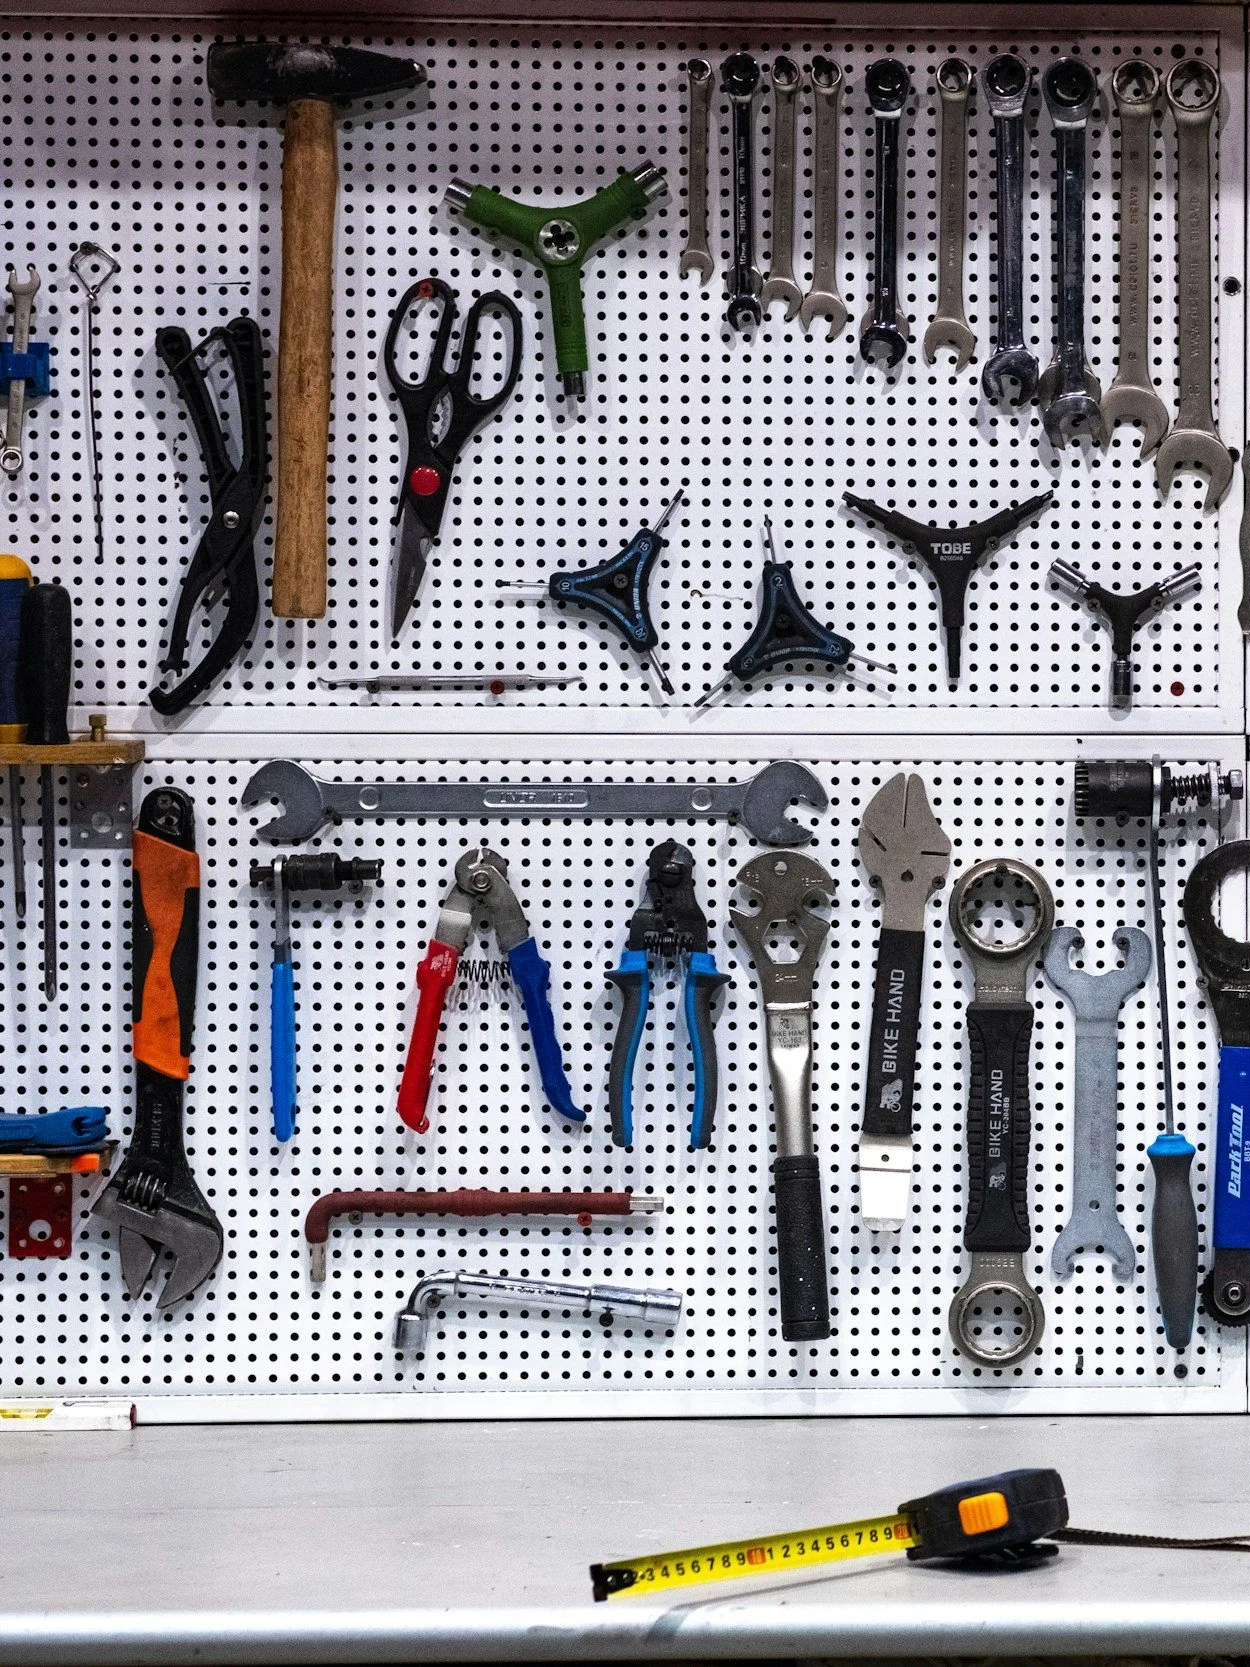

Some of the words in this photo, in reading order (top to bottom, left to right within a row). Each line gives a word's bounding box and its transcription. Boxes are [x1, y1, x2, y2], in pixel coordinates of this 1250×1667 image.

[639, 541, 650, 552] 15
[930, 542, 972, 555] TOBE
[561, 581, 570, 591] 10
[775, 576, 783, 587] 2
[886, 969, 905, 1023] HAND
[881, 1028, 900, 1073] BIKE
[990, 1069, 1003, 1115] HAND
[1002, 1096, 1010, 1135] YC-304BB
[1229, 1103, 1244, 1148] Tool
[988, 1119, 1002, 1158] BIKE
[1227, 1150, 1242, 1199] Park
[645, 1567, 655, 1582] 3
[661, 1565, 670, 1578] 4
[676, 1563, 685, 1576] 5
[691, 1560, 701, 1573] 6
[706, 1557, 715, 1571] 7
[721, 1554, 731, 1568] 8
[736, 1552, 746, 1566] 9
[767, 1547, 774, 1560] 1
[782, 1545, 791, 1558] 2
[796, 1542, 806, 1555] 3
[811, 1539, 821, 1553] 4
[825, 1537, 835, 1550] 5
[840, 1534, 850, 1548] 6
[855, 1532, 864, 1545] 7
[869, 1529, 879, 1543] 8
[883, 1527, 893, 1540] 9
